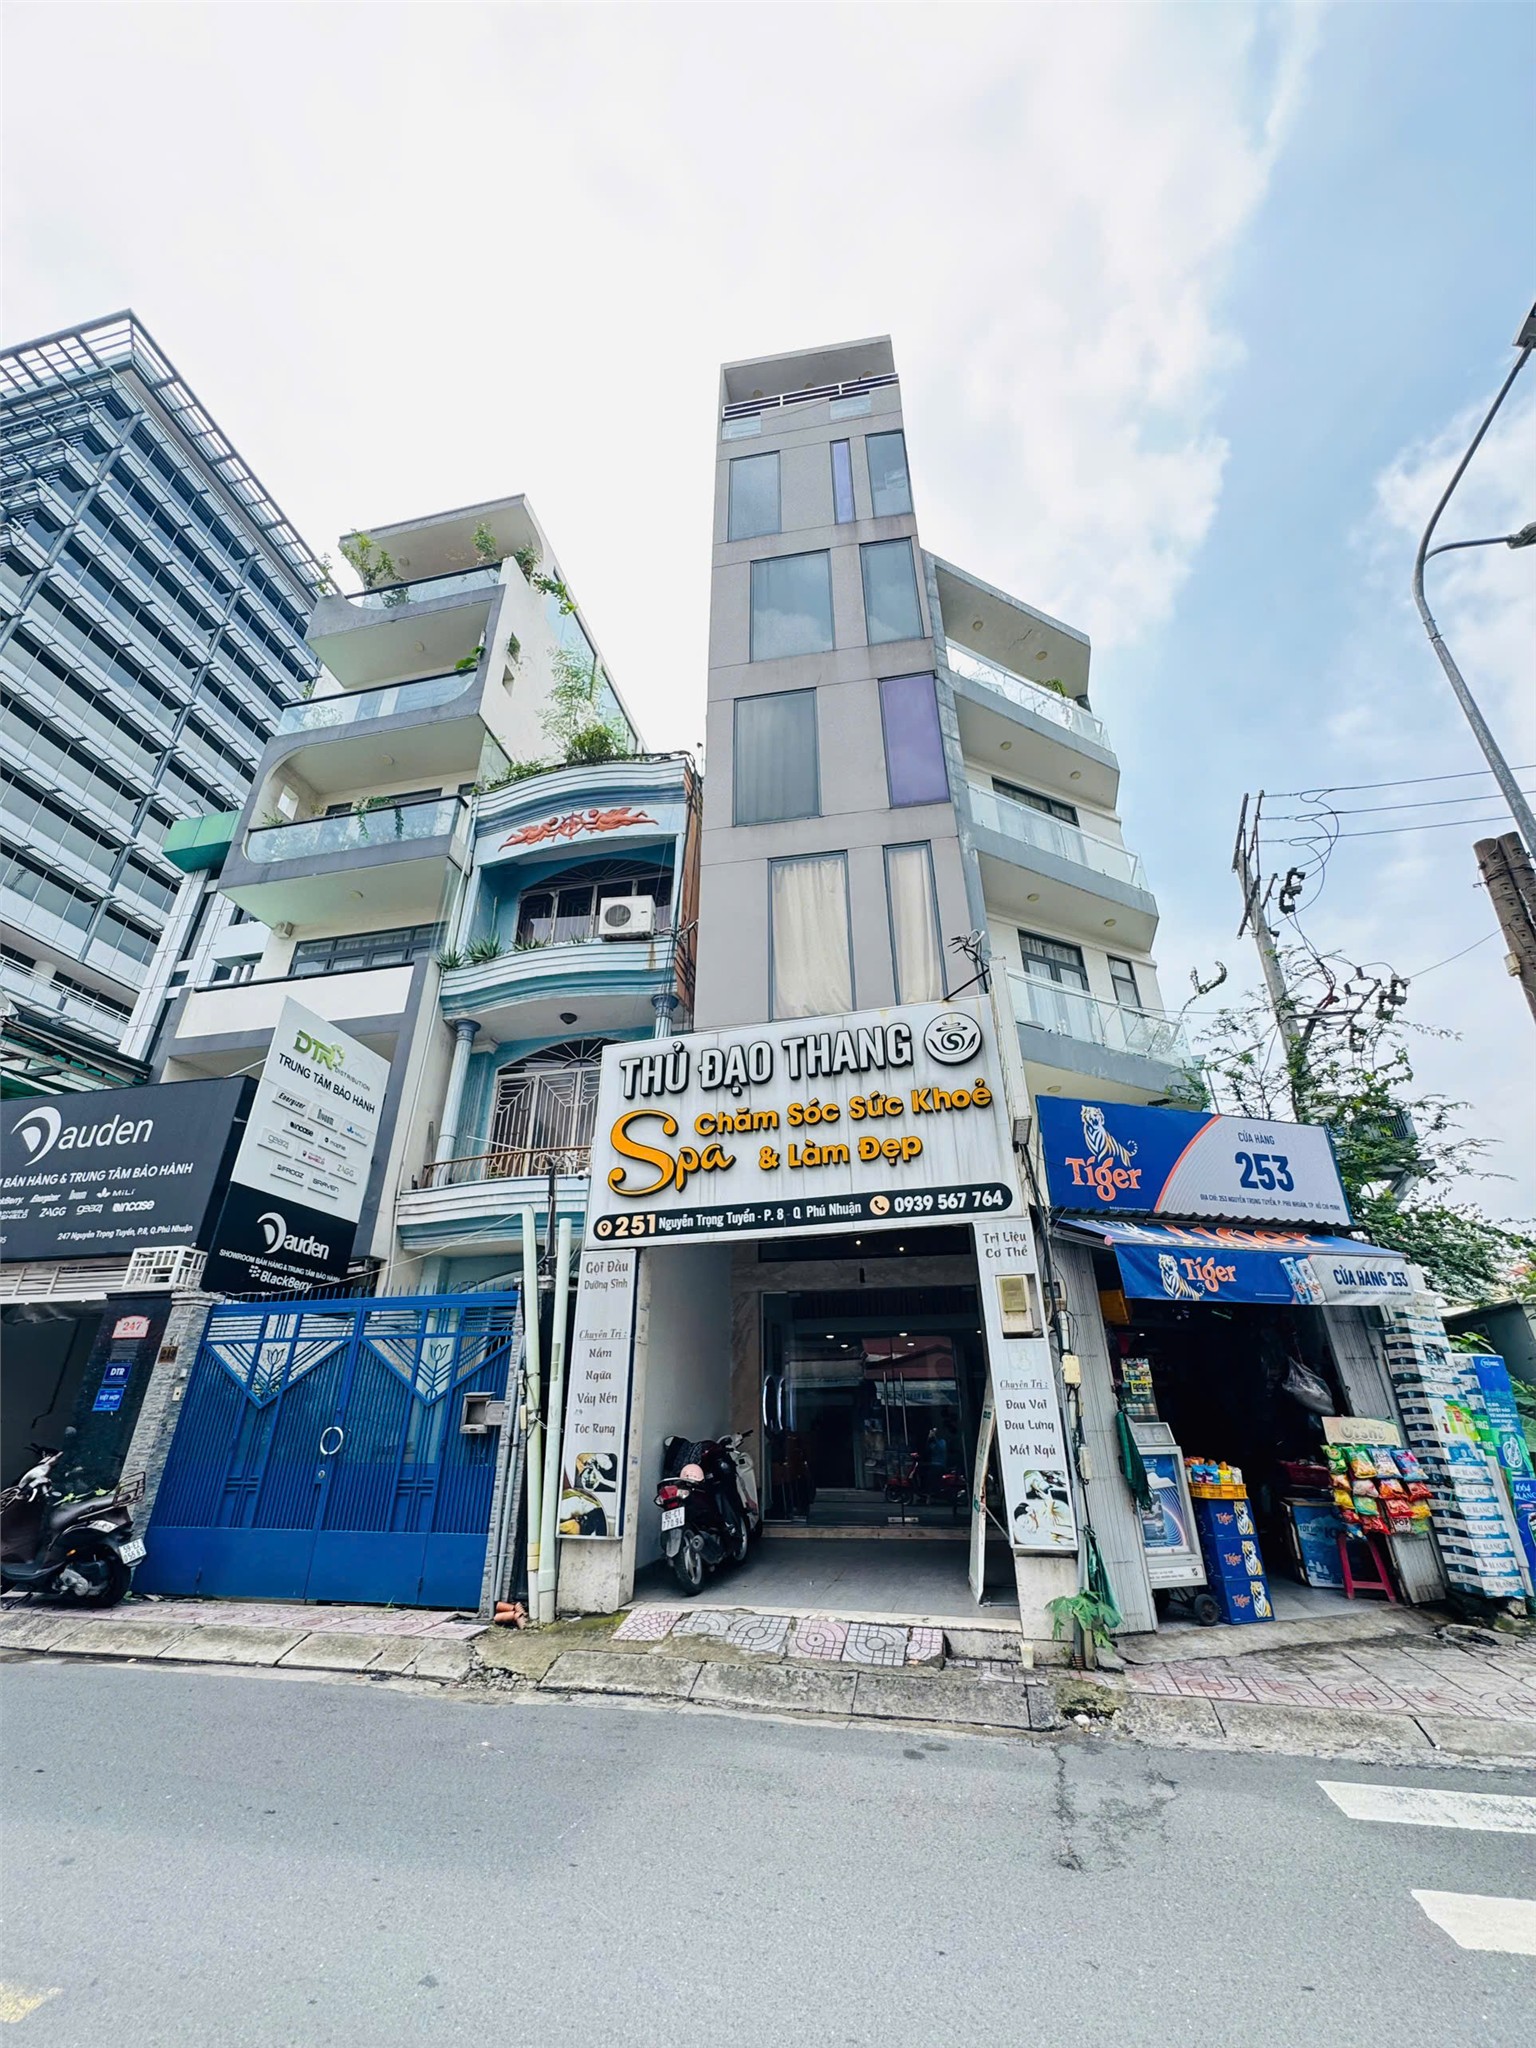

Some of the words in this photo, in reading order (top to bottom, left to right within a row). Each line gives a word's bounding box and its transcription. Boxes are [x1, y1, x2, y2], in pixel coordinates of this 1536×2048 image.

[620, 1041, 690, 1100] THỦ
[698, 1040, 774, 1097] ĐẠO
[781, 1022, 914, 1080] THANG
[279, 1052, 311, 1079] TRUNG
[313, 1072, 332, 1091] TÂM
[332, 1084, 352, 1101] BẢO
[352, 1094, 376, 1115] HÀNH
[694, 1108, 780, 1136] Chăm
[787, 1098, 841, 1127] Sóc
[849, 1091, 904, 1120] Sức
[910, 1078, 993, 1115] Khoẻ
[1238, 1130, 1254, 1144] CỬA
[1254, 1132, 1276, 1146] HÀNG
[607, 1109, 736, 1197] Spa
[759, 1146, 780, 1170] &
[788, 1139, 850, 1168] Làm
[858, 1135, 923, 1166] Đẹp
[3, 1174, 26, 1188] BÁN
[26, 1172, 59, 1187] HÀNG
[60, 1173, 68, 1184] &
[69, 1170, 106, 1183] TRUNG
[107, 1167, 132, 1180] TÂM
[132, 1164, 159, 1179] BẢO
[159, 1162, 194, 1176] HÀNH
[1065, 1156, 1142, 1202] Tiger
[1235, 1151, 1295, 1192] 253
[894, 1196, 934, 1213] 0939
[937, 1193, 967, 1209] 567
[972, 1190, 1004, 1206] 764
[39, 1206, 67, 1218] ZAGG
[615, 1214, 656, 1237] 251
[659, 1213, 693, 1231] Nguyễn
[696, 1212, 724, 1227] Trọng
[726, 1208, 755, 1226] Tuyển
[776, 1208, 785, 1220] 8
[806, 1203, 826, 1218] Phú
[829, 1201, 862, 1218] Nhuận
[57, 1232, 71, 1241] 247
[96, 1229, 115, 1239] Trọng
[171, 1223, 194, 1234] Nhuận
[983, 1232, 999, 1246] Trị
[1003, 1231, 1027, 1244] Liệu
[985, 1247, 1001, 1258] Cơ
[1005, 1243, 1028, 1257] Thể
[219, 1248, 256, 1263] SHOWROOM
[287, 1264, 305, 1275] TRUNG
[586, 1261, 604, 1275] Gội
[607, 1258, 629, 1273] Đầu
[260, 1270, 313, 1293] BlackBerry
[1180, 1256, 1237, 1293] Tiger
[1333, 1264, 1357, 1285] CỬA
[1356, 1266, 1388, 1287] HÀNG
[1387, 1271, 1409, 1287] 253
[610, 1278, 628, 1289] Sinh
[122, 1321, 143, 1332] 247
[579, 1329, 607, 1342] Chuyên
[589, 1347, 612, 1358] Nám
[110, 1367, 125, 1376] DTR
[1000, 1379, 1028, 1391] Chuyên
[577, 1392, 597, 1407] Vảy
[599, 1392, 618, 1404] Nến
[1005, 1399, 1026, 1410] Đau
[1029, 1398, 1048, 1410] Vai
[574, 1423, 590, 1434] Tóc
[1004, 1420, 1025, 1431] Đau
[1028, 1420, 1055, 1433] Lưng
[1009, 1443, 1030, 1456] Mất
[1033, 1444, 1056, 1460] Ngủ
